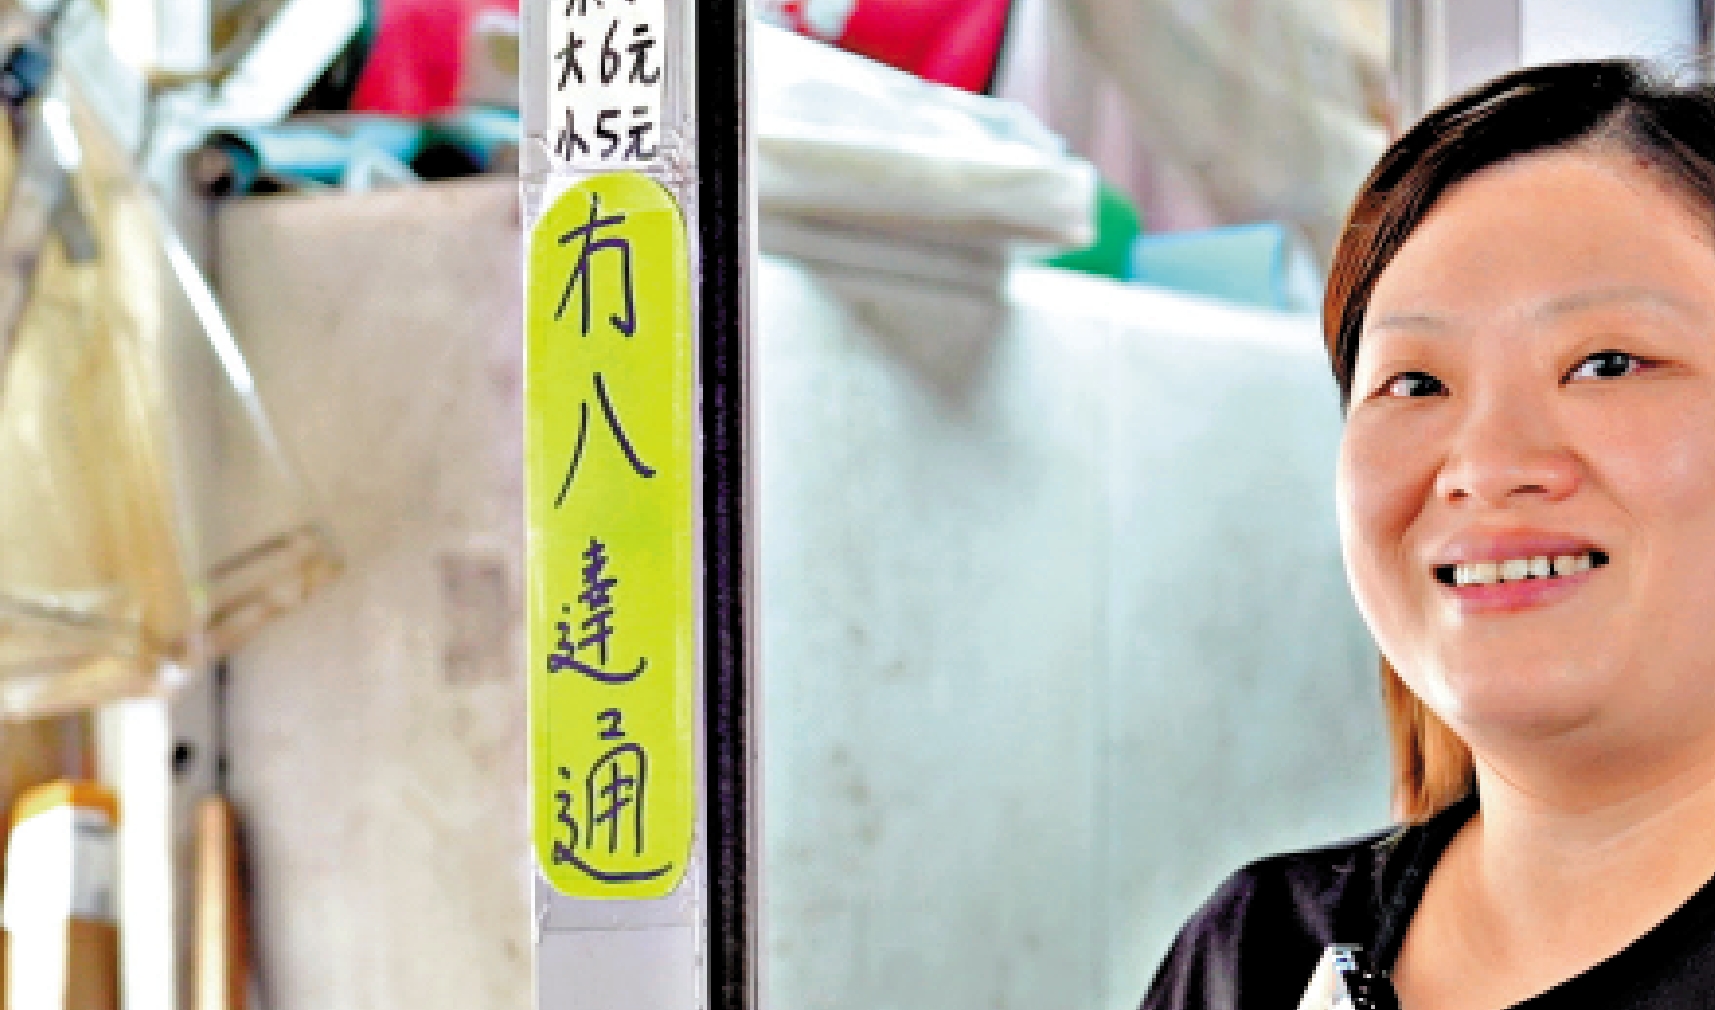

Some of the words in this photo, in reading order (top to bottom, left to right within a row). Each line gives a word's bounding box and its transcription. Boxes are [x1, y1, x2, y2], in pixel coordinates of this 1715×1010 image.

[554, 16, 660, 91] 大6元
[554, 106, 656, 161] 小5元
[546, 192, 673, 881] 冇八達通
